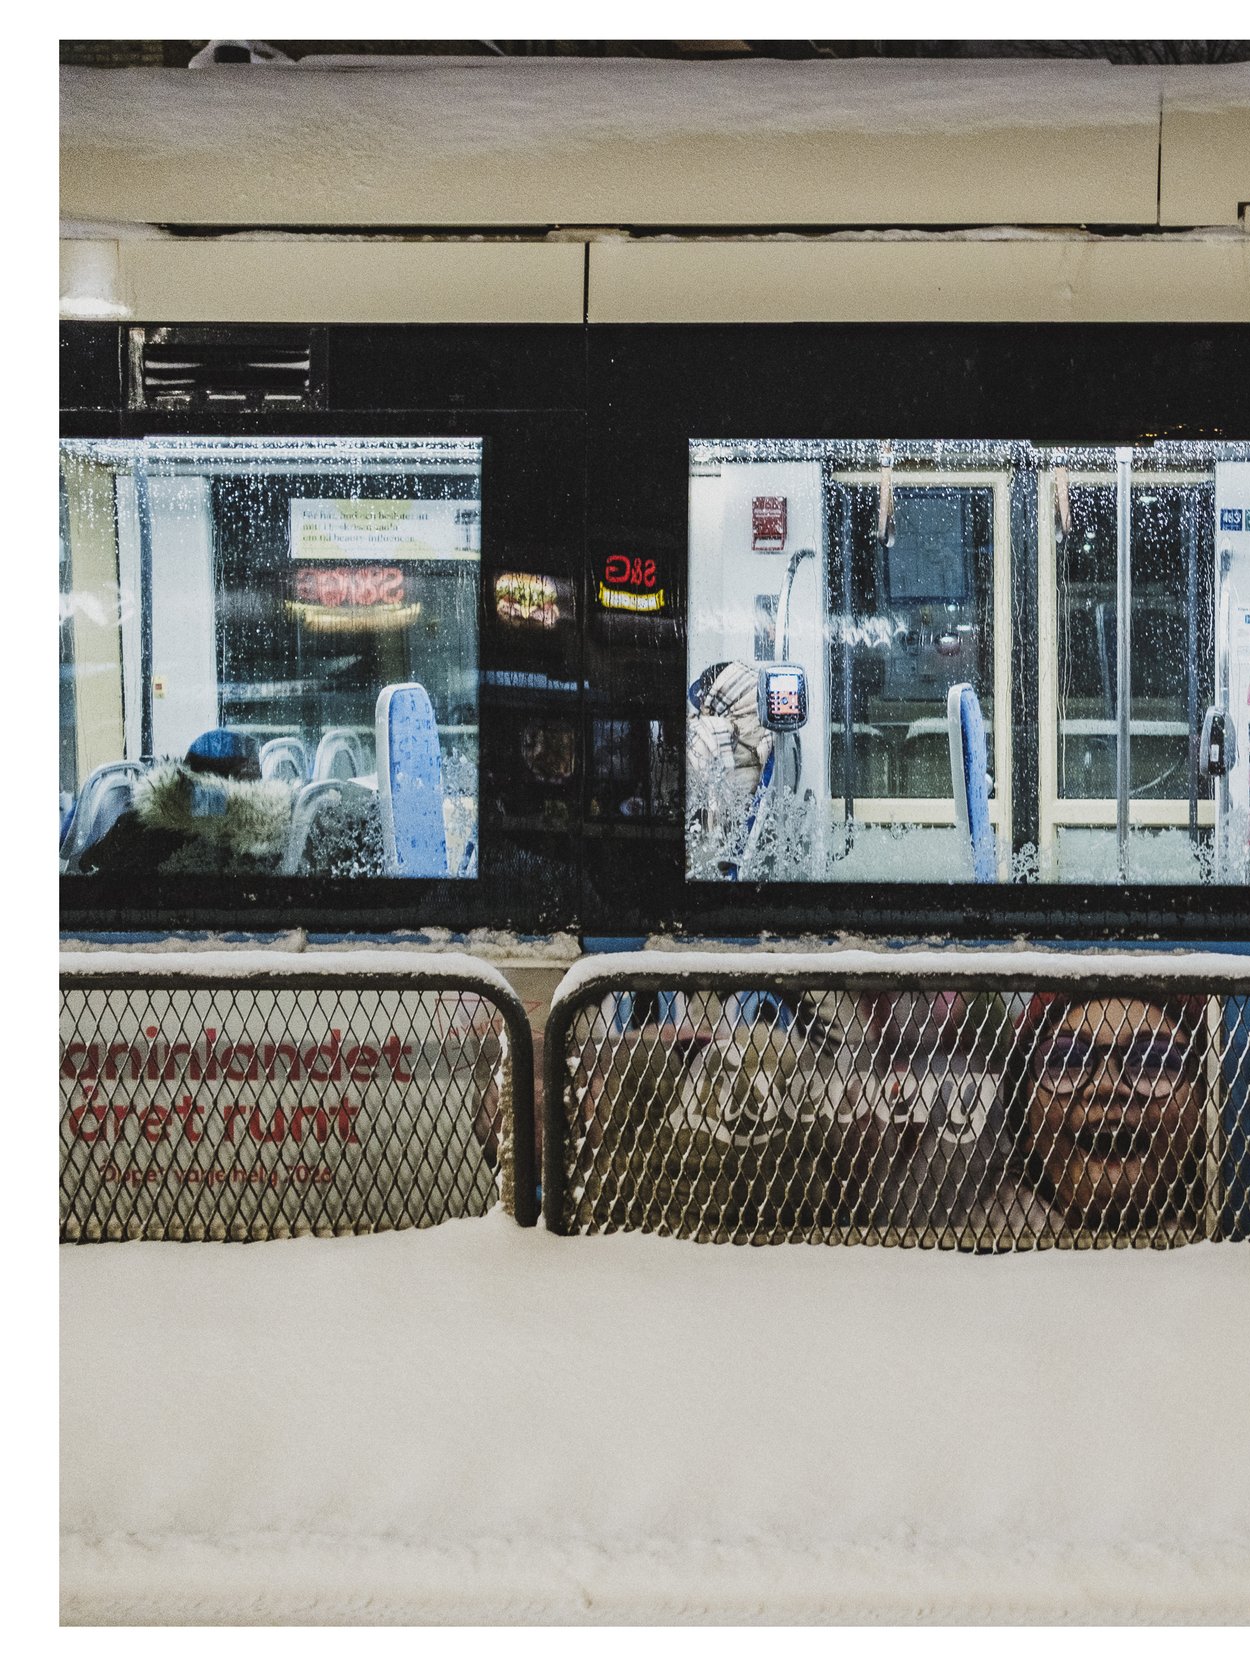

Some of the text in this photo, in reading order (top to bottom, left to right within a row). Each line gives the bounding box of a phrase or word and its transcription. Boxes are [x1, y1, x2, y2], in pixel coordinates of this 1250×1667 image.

[59, 1025, 413, 1082] aninlandet
[69, 1085, 359, 1143] året runt
[233, 1164, 278, 1188] helg
